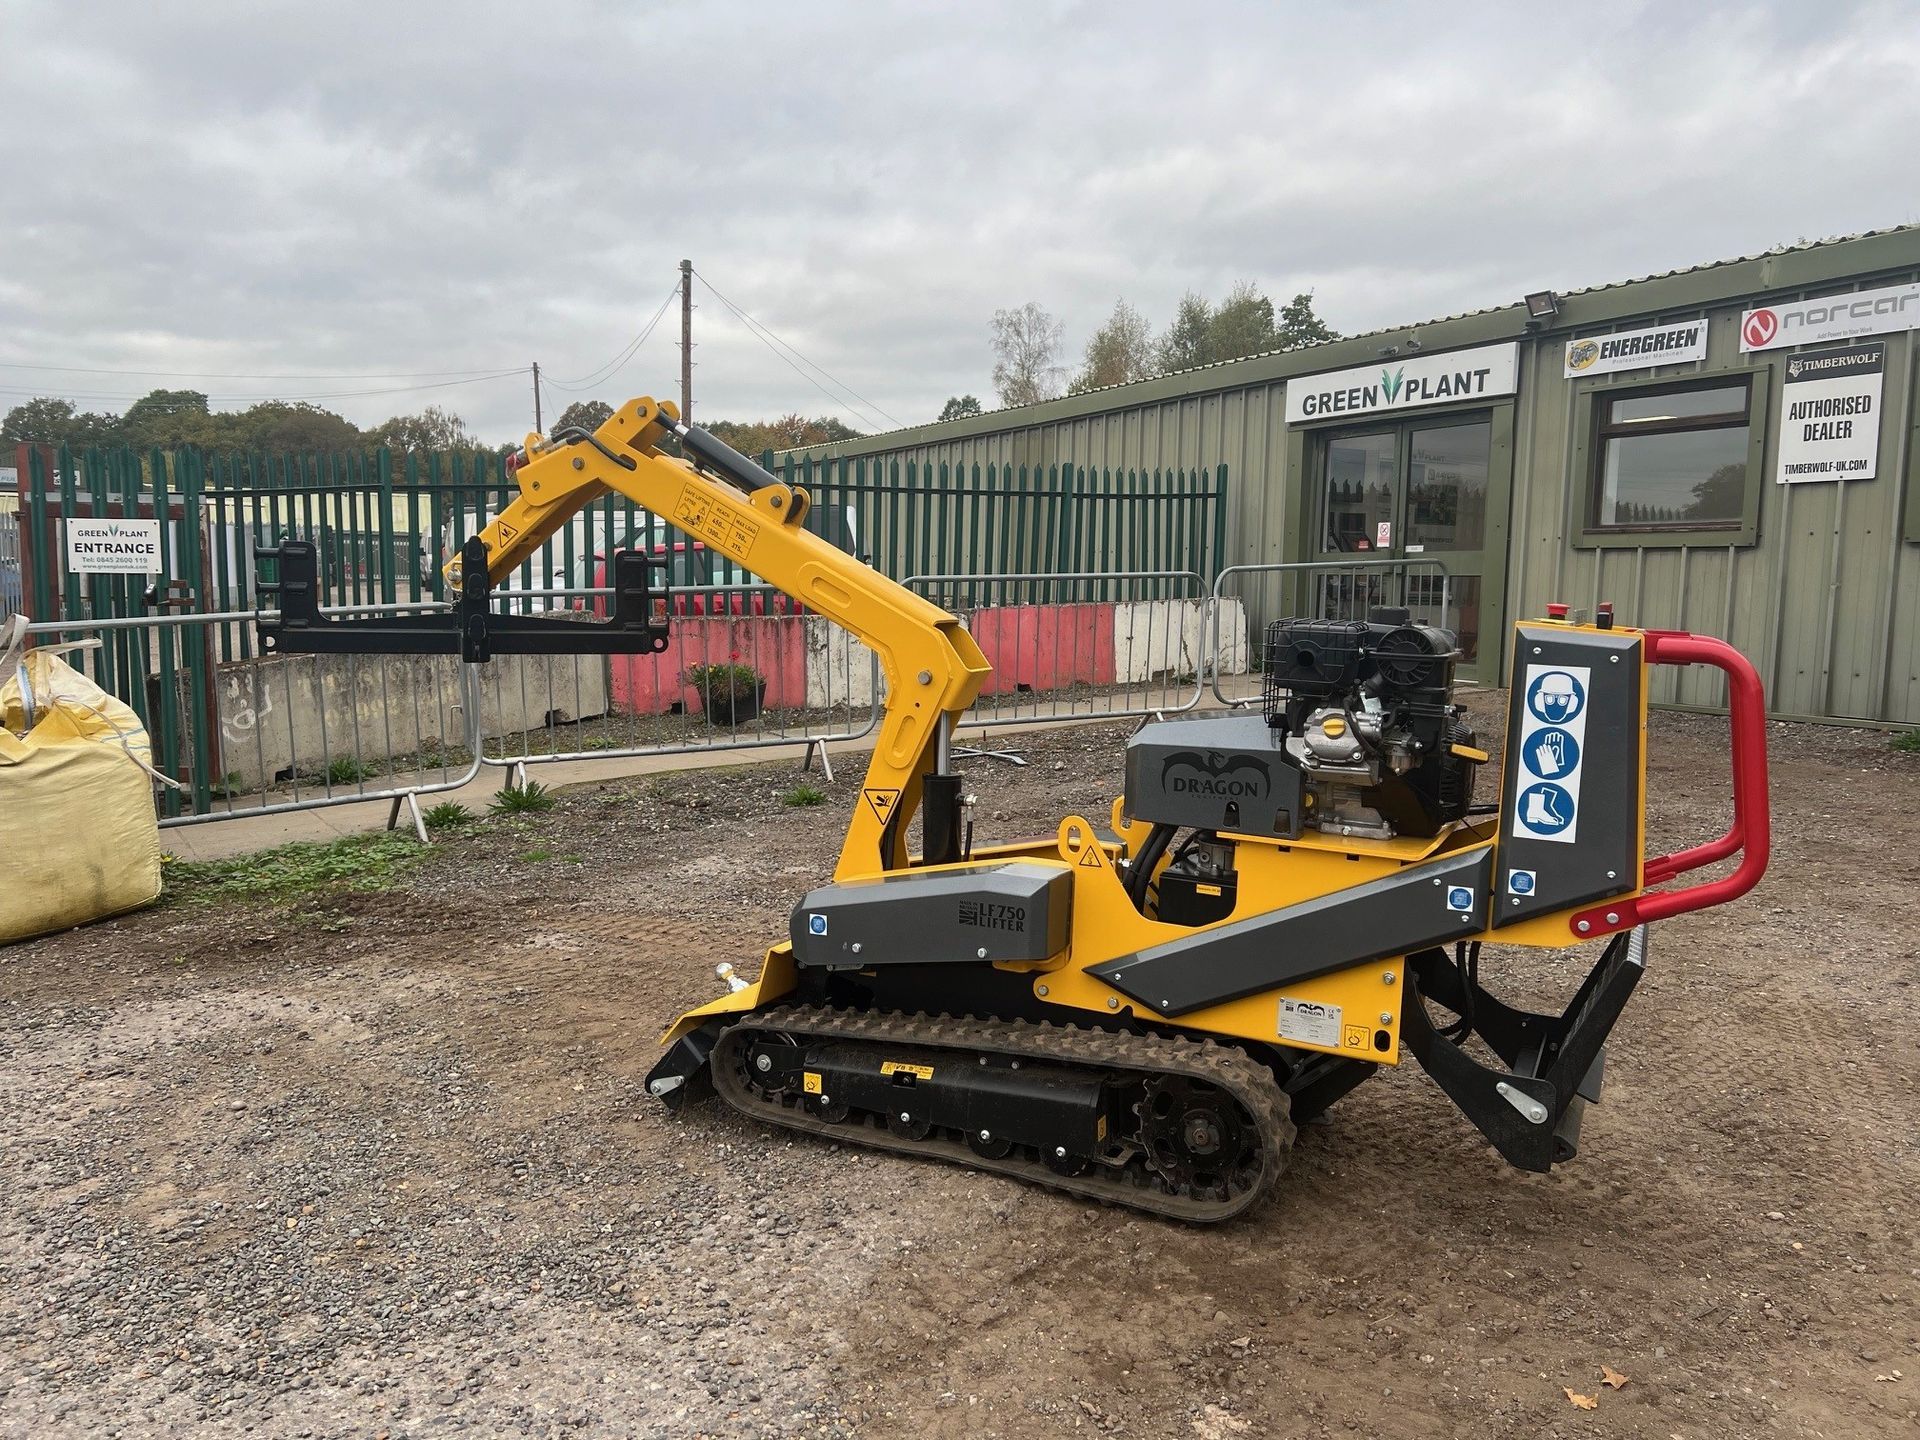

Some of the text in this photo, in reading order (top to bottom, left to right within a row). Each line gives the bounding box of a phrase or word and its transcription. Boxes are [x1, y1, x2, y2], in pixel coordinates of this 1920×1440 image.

[1783, 293, 1920, 329] norcar
[1600, 327, 1699, 360] ENERGREEN
[1803, 352, 1880, 371] TIMBERWOLF
[1302, 368, 1491, 416] GREEN PLANT
[1789, 395, 1872, 420] AUTHORISED
[1803, 420, 1853, 442] DEALER
[1785, 460, 1868, 475] TIMBERWOLF-UK.COM
[119, 530, 149, 538] PLANT
[74, 543, 154, 554] ENTRANCE
[1173, 777, 1258, 797] DRAGON
[980, 916, 1025, 933] LIFTER
[1300, 1008, 1322, 1016] DRAGON
